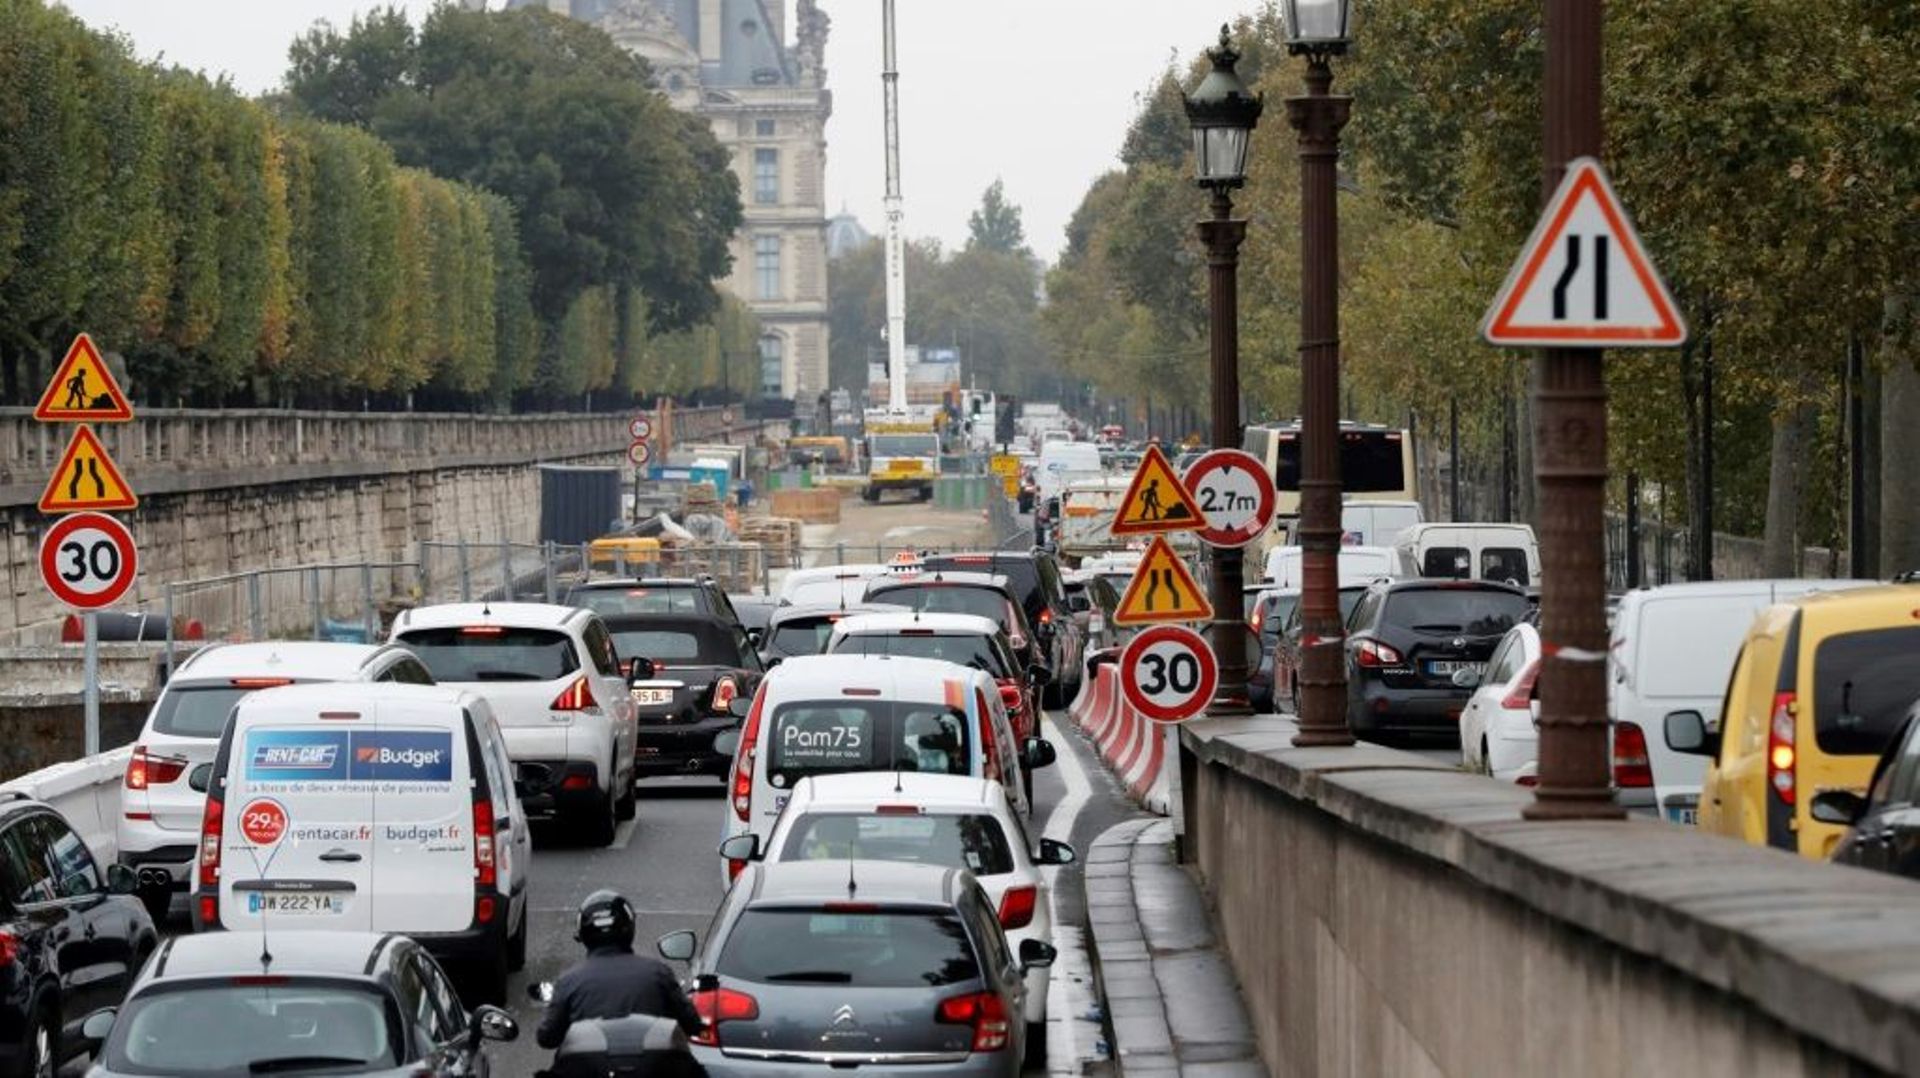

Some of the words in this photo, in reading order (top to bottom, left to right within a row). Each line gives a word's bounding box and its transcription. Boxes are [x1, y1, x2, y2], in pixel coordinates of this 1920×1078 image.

[1201, 487, 1256, 511] 2.7m
[61, 541, 119, 582] 30
[1140, 652, 1198, 694] 30
[784, 725, 861, 747] Pam75
[380, 749, 440, 767] Budget
[291, 825, 371, 840] rentacar.fr
[387, 825, 459, 844] budget.fr
